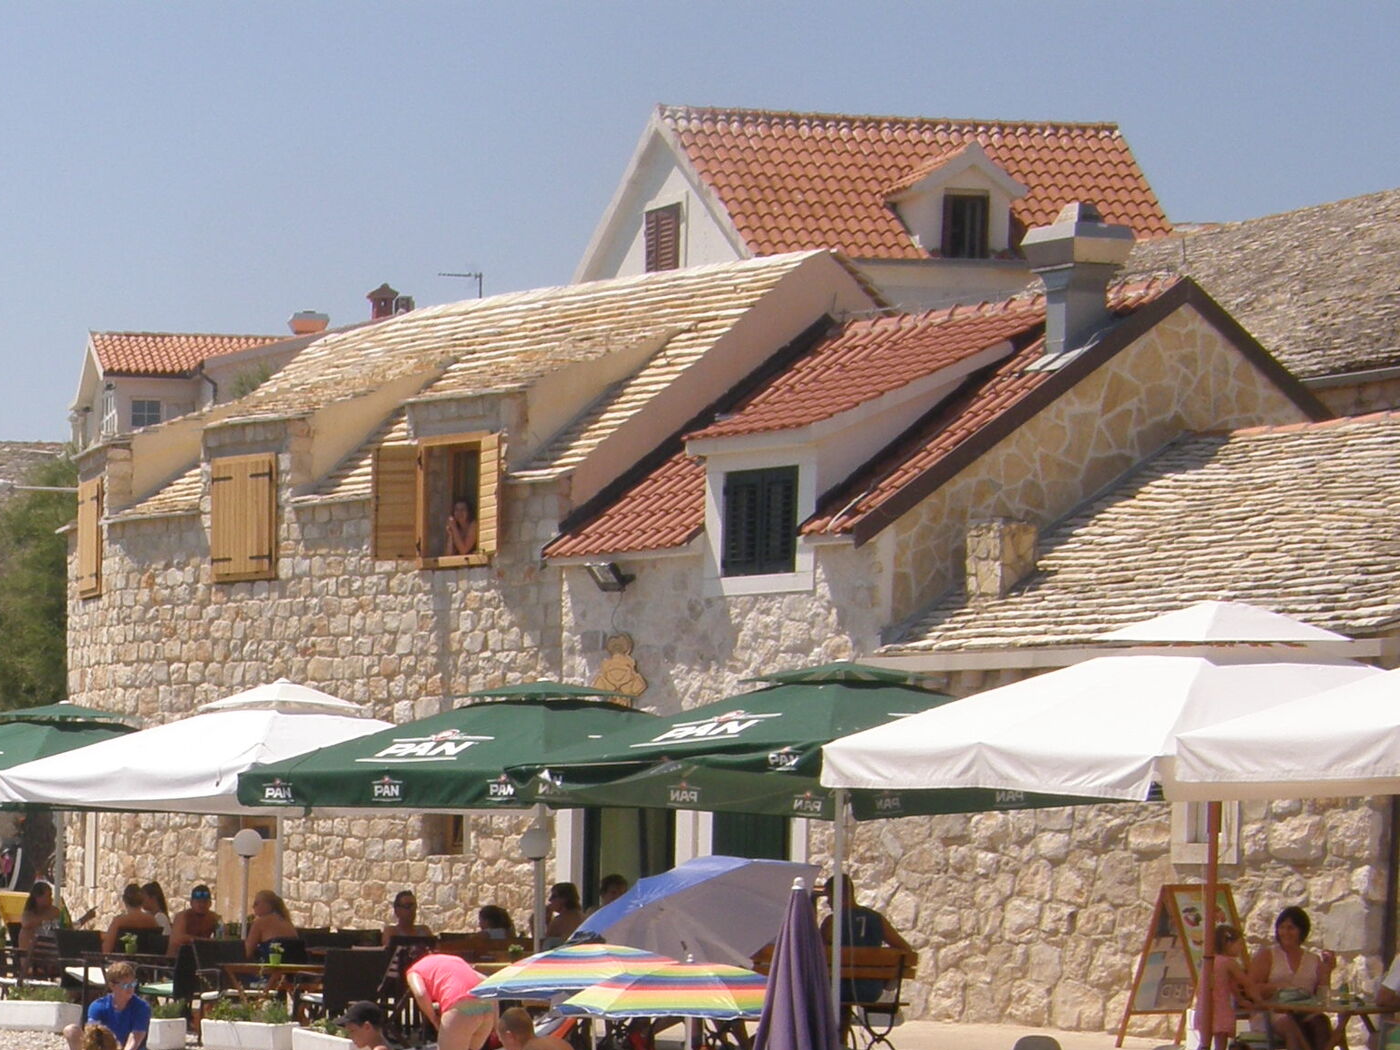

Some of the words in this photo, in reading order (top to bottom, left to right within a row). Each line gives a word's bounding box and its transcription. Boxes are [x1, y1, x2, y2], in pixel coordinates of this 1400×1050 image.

[652, 719, 763, 741] PAN
[375, 742, 477, 757] PAN
[264, 787, 292, 799] PAN
[374, 784, 400, 797] PAN
[856, 916, 867, 937] 7
